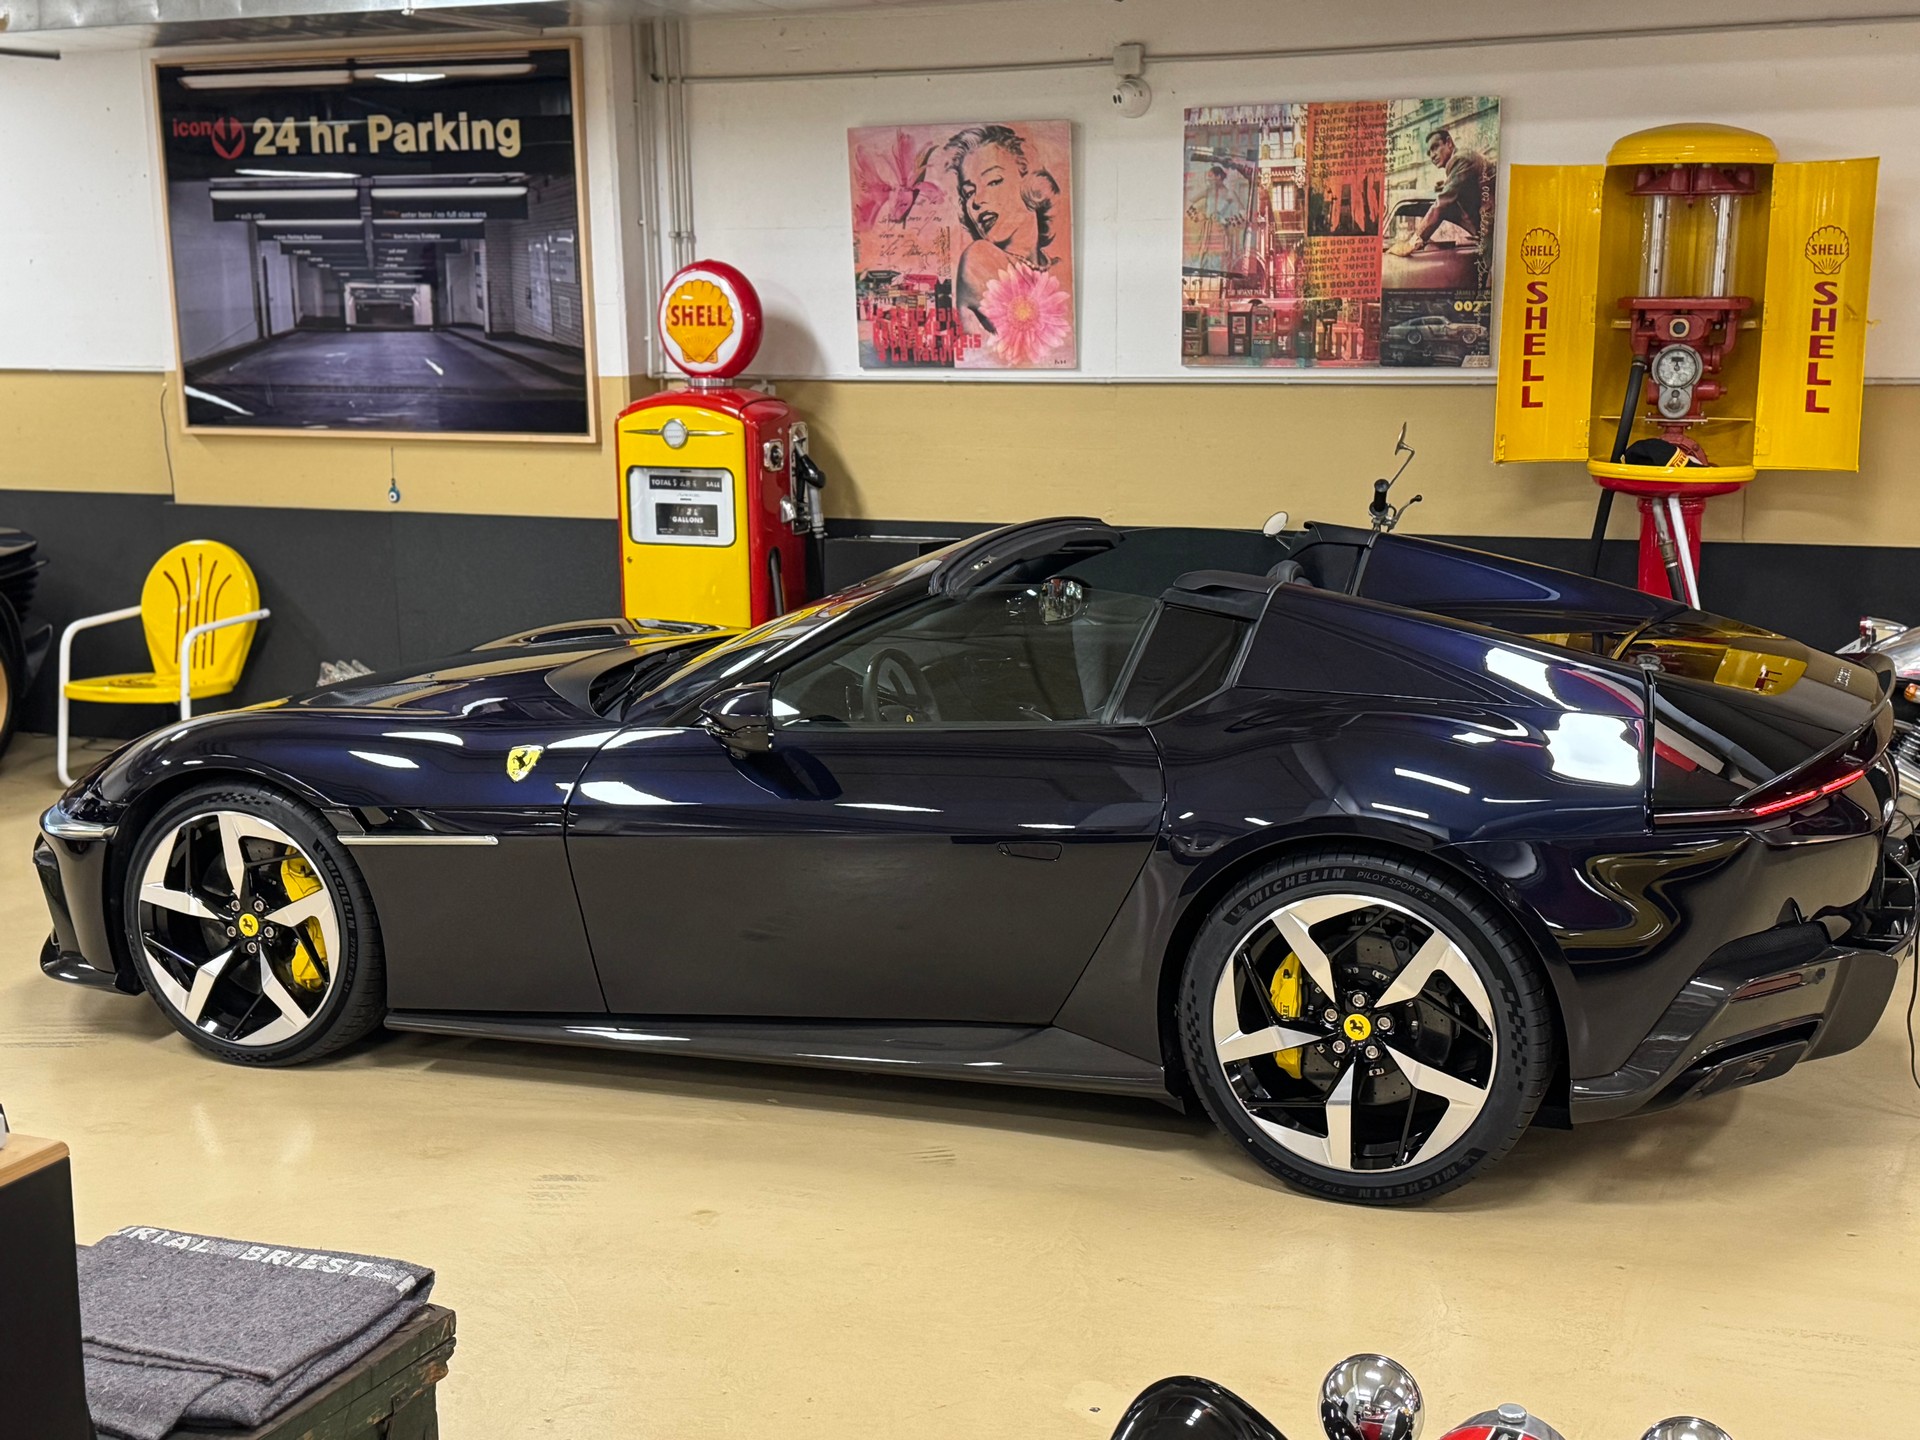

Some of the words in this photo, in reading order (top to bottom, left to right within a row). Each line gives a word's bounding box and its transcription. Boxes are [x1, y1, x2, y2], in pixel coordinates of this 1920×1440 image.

[172, 118, 212, 137] icon
[253, 117, 300, 155] 24
[309, 115, 357, 154] hr.
[367, 111, 521, 158] Parking
[1525, 245, 1554, 257] SHELL
[1810, 243, 1845, 256] SHELL
[671, 304, 727, 327] SHELL
[1454, 300, 1483, 312] 007
[1521, 281, 1549, 409] SHELL
[1804, 281, 1838, 414] SHELL
[651, 479, 671, 487] TOTAL
[671, 516, 704, 524] GALLONS
[323, 858, 357, 930] MICHELIN
[1249, 867, 1346, 908] MICHELIN
[1356, 871, 1387, 882] PILOT
[1388, 877, 1423, 896] SPORT
[1358, 1165, 1459, 1198] MICHELIN
